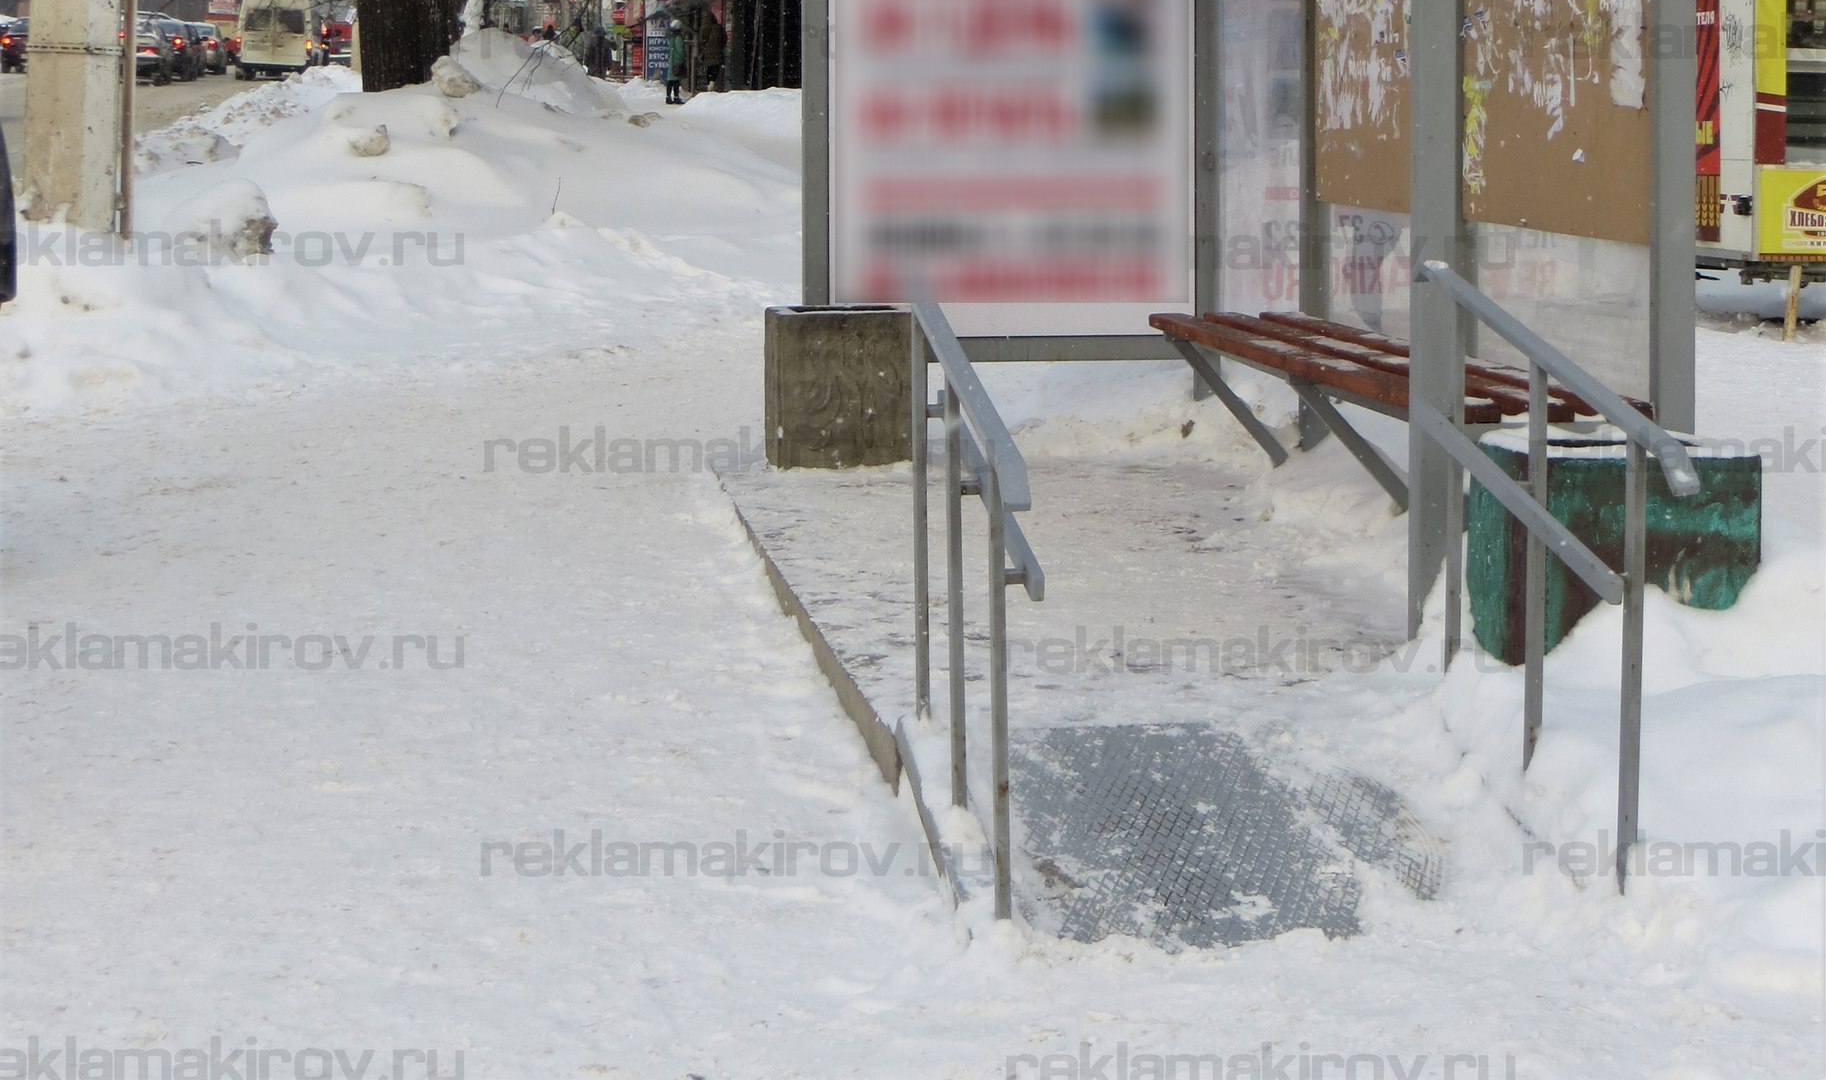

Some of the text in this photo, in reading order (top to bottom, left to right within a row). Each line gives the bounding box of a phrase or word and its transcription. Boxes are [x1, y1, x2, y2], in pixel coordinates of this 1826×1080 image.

[1696, 11, 1715, 26] ТЕЛЯ
[649, 38, 670, 46] ИГРУ
[1696, 120, 1714, 146] ЫЕ
